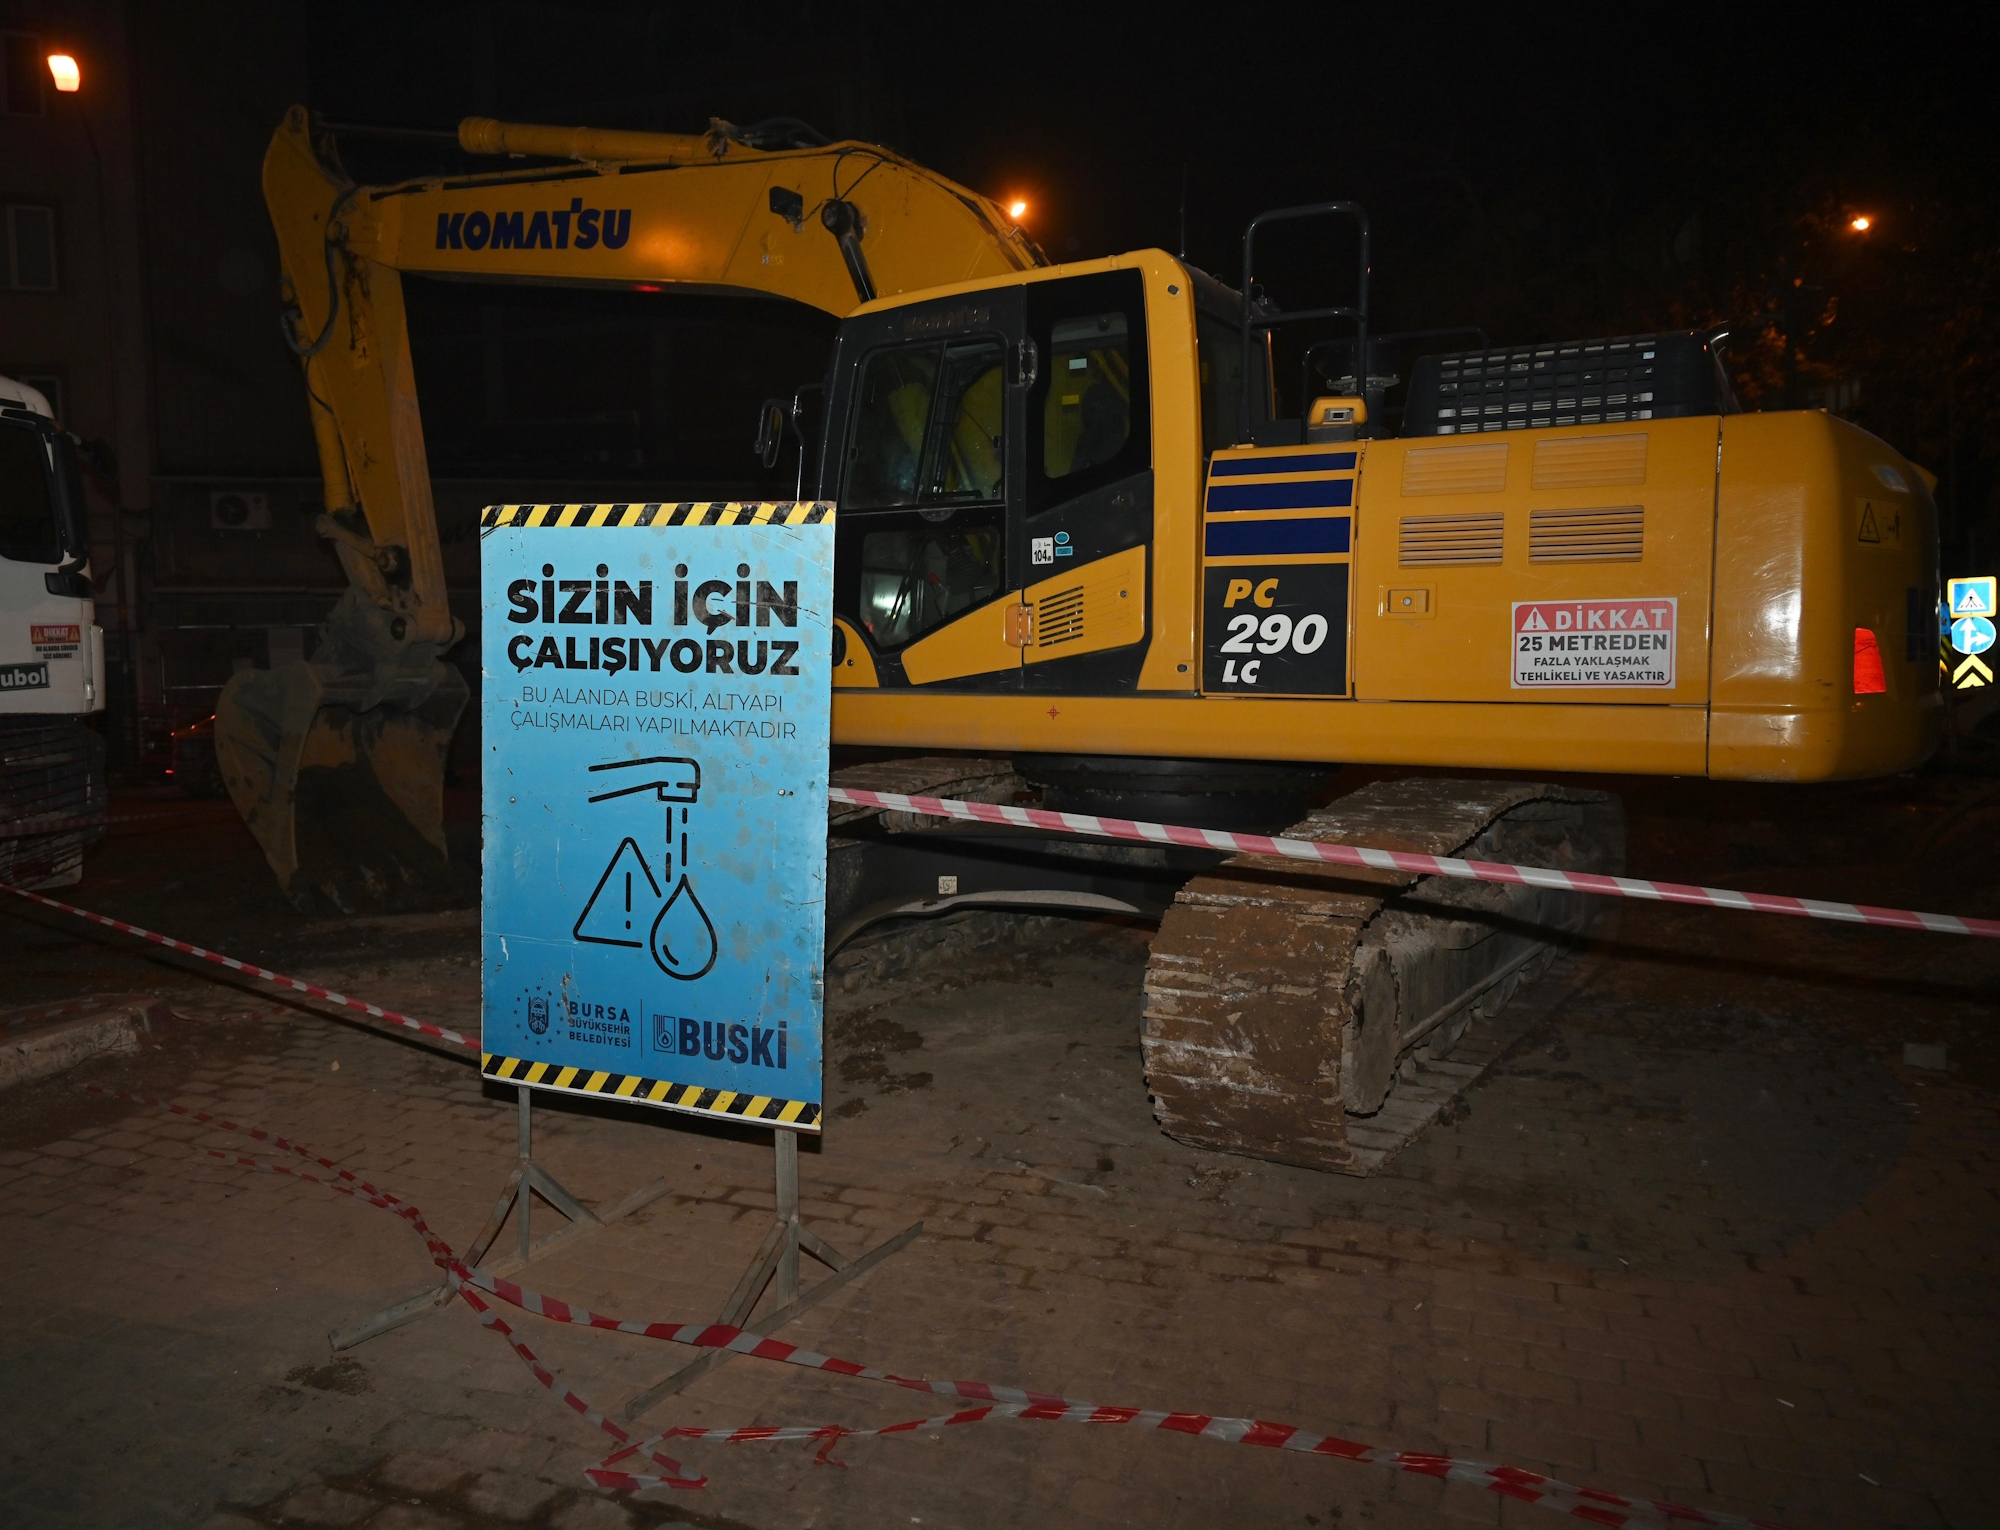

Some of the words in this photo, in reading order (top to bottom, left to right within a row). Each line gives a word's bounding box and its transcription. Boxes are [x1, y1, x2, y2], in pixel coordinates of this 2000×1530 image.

[435, 198, 632, 251] KOMATSU
[1034, 549, 1047, 562] 104
[507, 563, 653, 625] SİZİN
[673, 563, 798, 635] İÇİN
[1223, 578, 1279, 609] PC
[1555, 604, 1668, 630] DİKKAT
[1219, 613, 1329, 655] 290
[1519, 636, 1543, 652] 25
[1549, 634, 1667, 651] METREDEN
[507, 635, 800, 677] ÇALIŞIYORUZ
[1534, 657, 1571, 667] FAZLA
[1574, 655, 1650, 667] YAKLAŞMAK
[0, 667, 47, 687] ubol
[1222, 660, 1261, 684] LC
[1520, 669, 1582, 681] TEHLİKELİ
[1585, 671, 1600, 681] VE
[1603, 671, 1665, 681] YASAKTIR
[522, 686, 547, 703] BU
[553, 687, 630, 708] ALANDA
[635, 689, 697, 713] BUSKİ,
[702, 693, 783, 713] ALTYAPI
[510, 710, 630, 732] ÇALIŞMALARI
[635, 716, 797, 740] YAPILMAKTADIR
[569, 1001, 631, 1023] BURSA
[568, 1017, 631, 1036] BÜYÜKŞEHİR
[569, 1030, 631, 1048] BELEDİYESİ
[679, 1017, 787, 1070] BUSKİ
